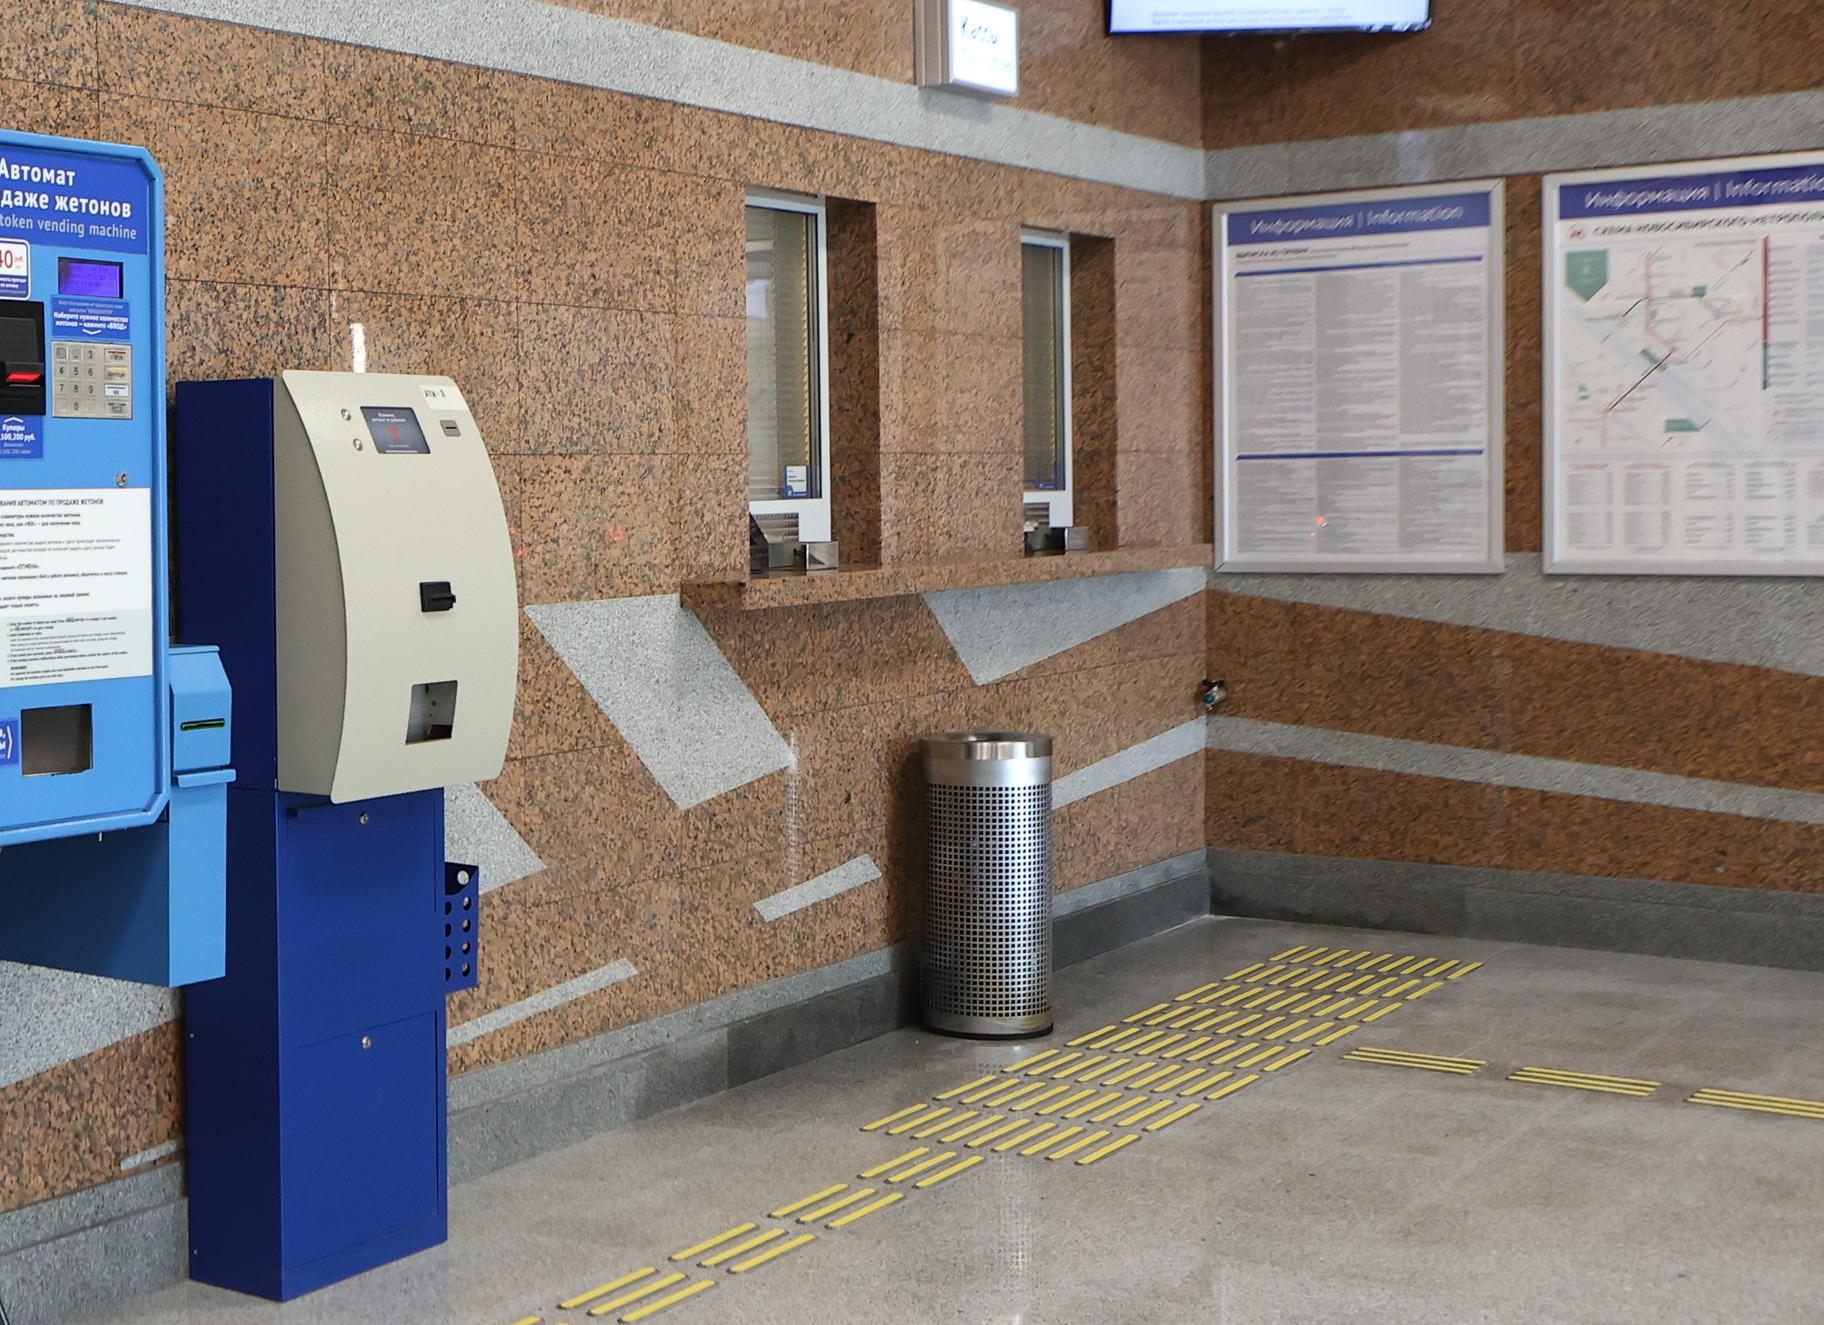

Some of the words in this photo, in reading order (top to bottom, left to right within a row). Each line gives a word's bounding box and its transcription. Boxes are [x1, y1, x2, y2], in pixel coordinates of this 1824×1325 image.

[54, 196, 132, 218] жетонов
[1584, 186, 1711, 210] Информация
[0, 213, 33, 230] token
[38, 218, 85, 238] vending
[89, 224, 137, 240] machine
[1250, 215, 1354, 235] Информация
[1366, 205, 1465, 227] Information
[74, 366, 79, 376] 5
[88, 368, 94, 376] 6
[59, 384, 64, 392] 7
